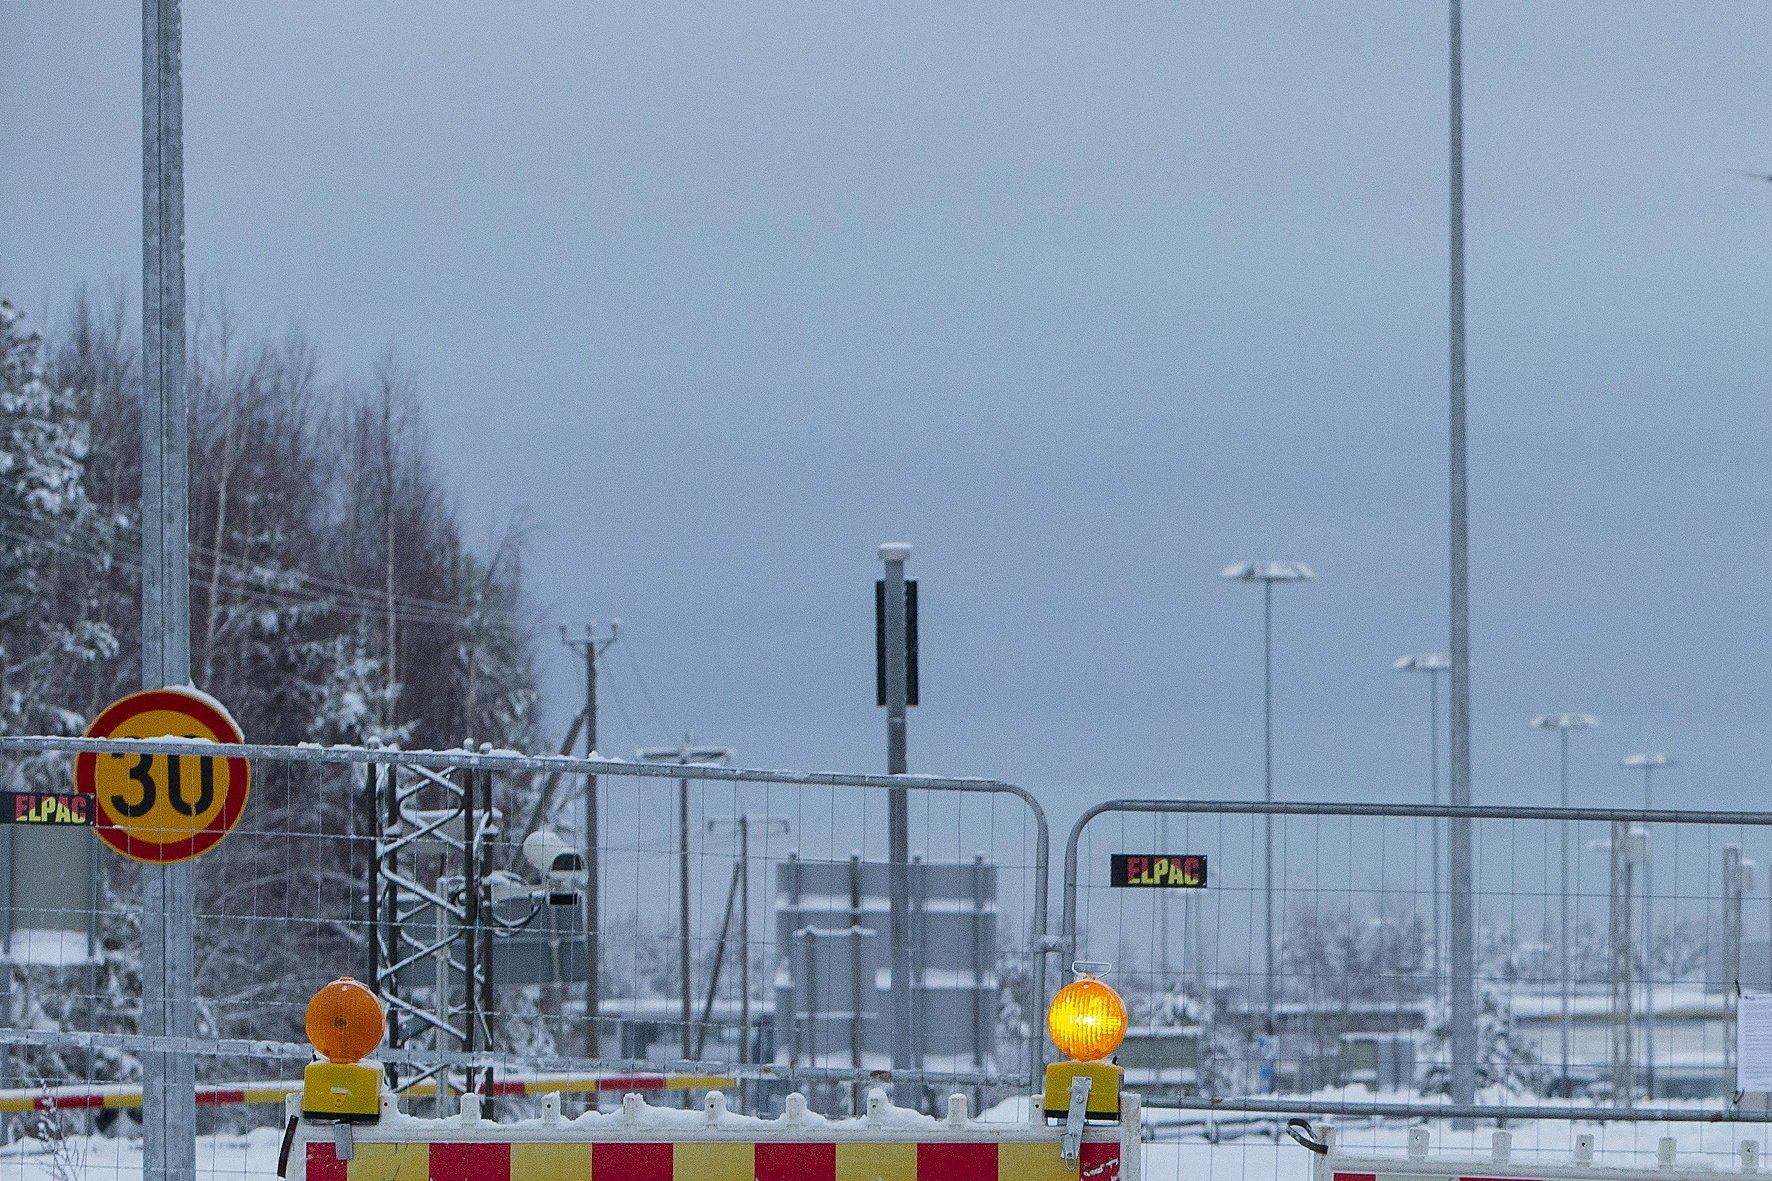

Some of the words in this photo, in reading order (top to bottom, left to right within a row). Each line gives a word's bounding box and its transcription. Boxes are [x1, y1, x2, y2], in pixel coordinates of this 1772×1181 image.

[110, 734, 214, 818] 30
[15, 794, 87, 824] ELPAC
[1127, 857, 1200, 885] ELPAC
